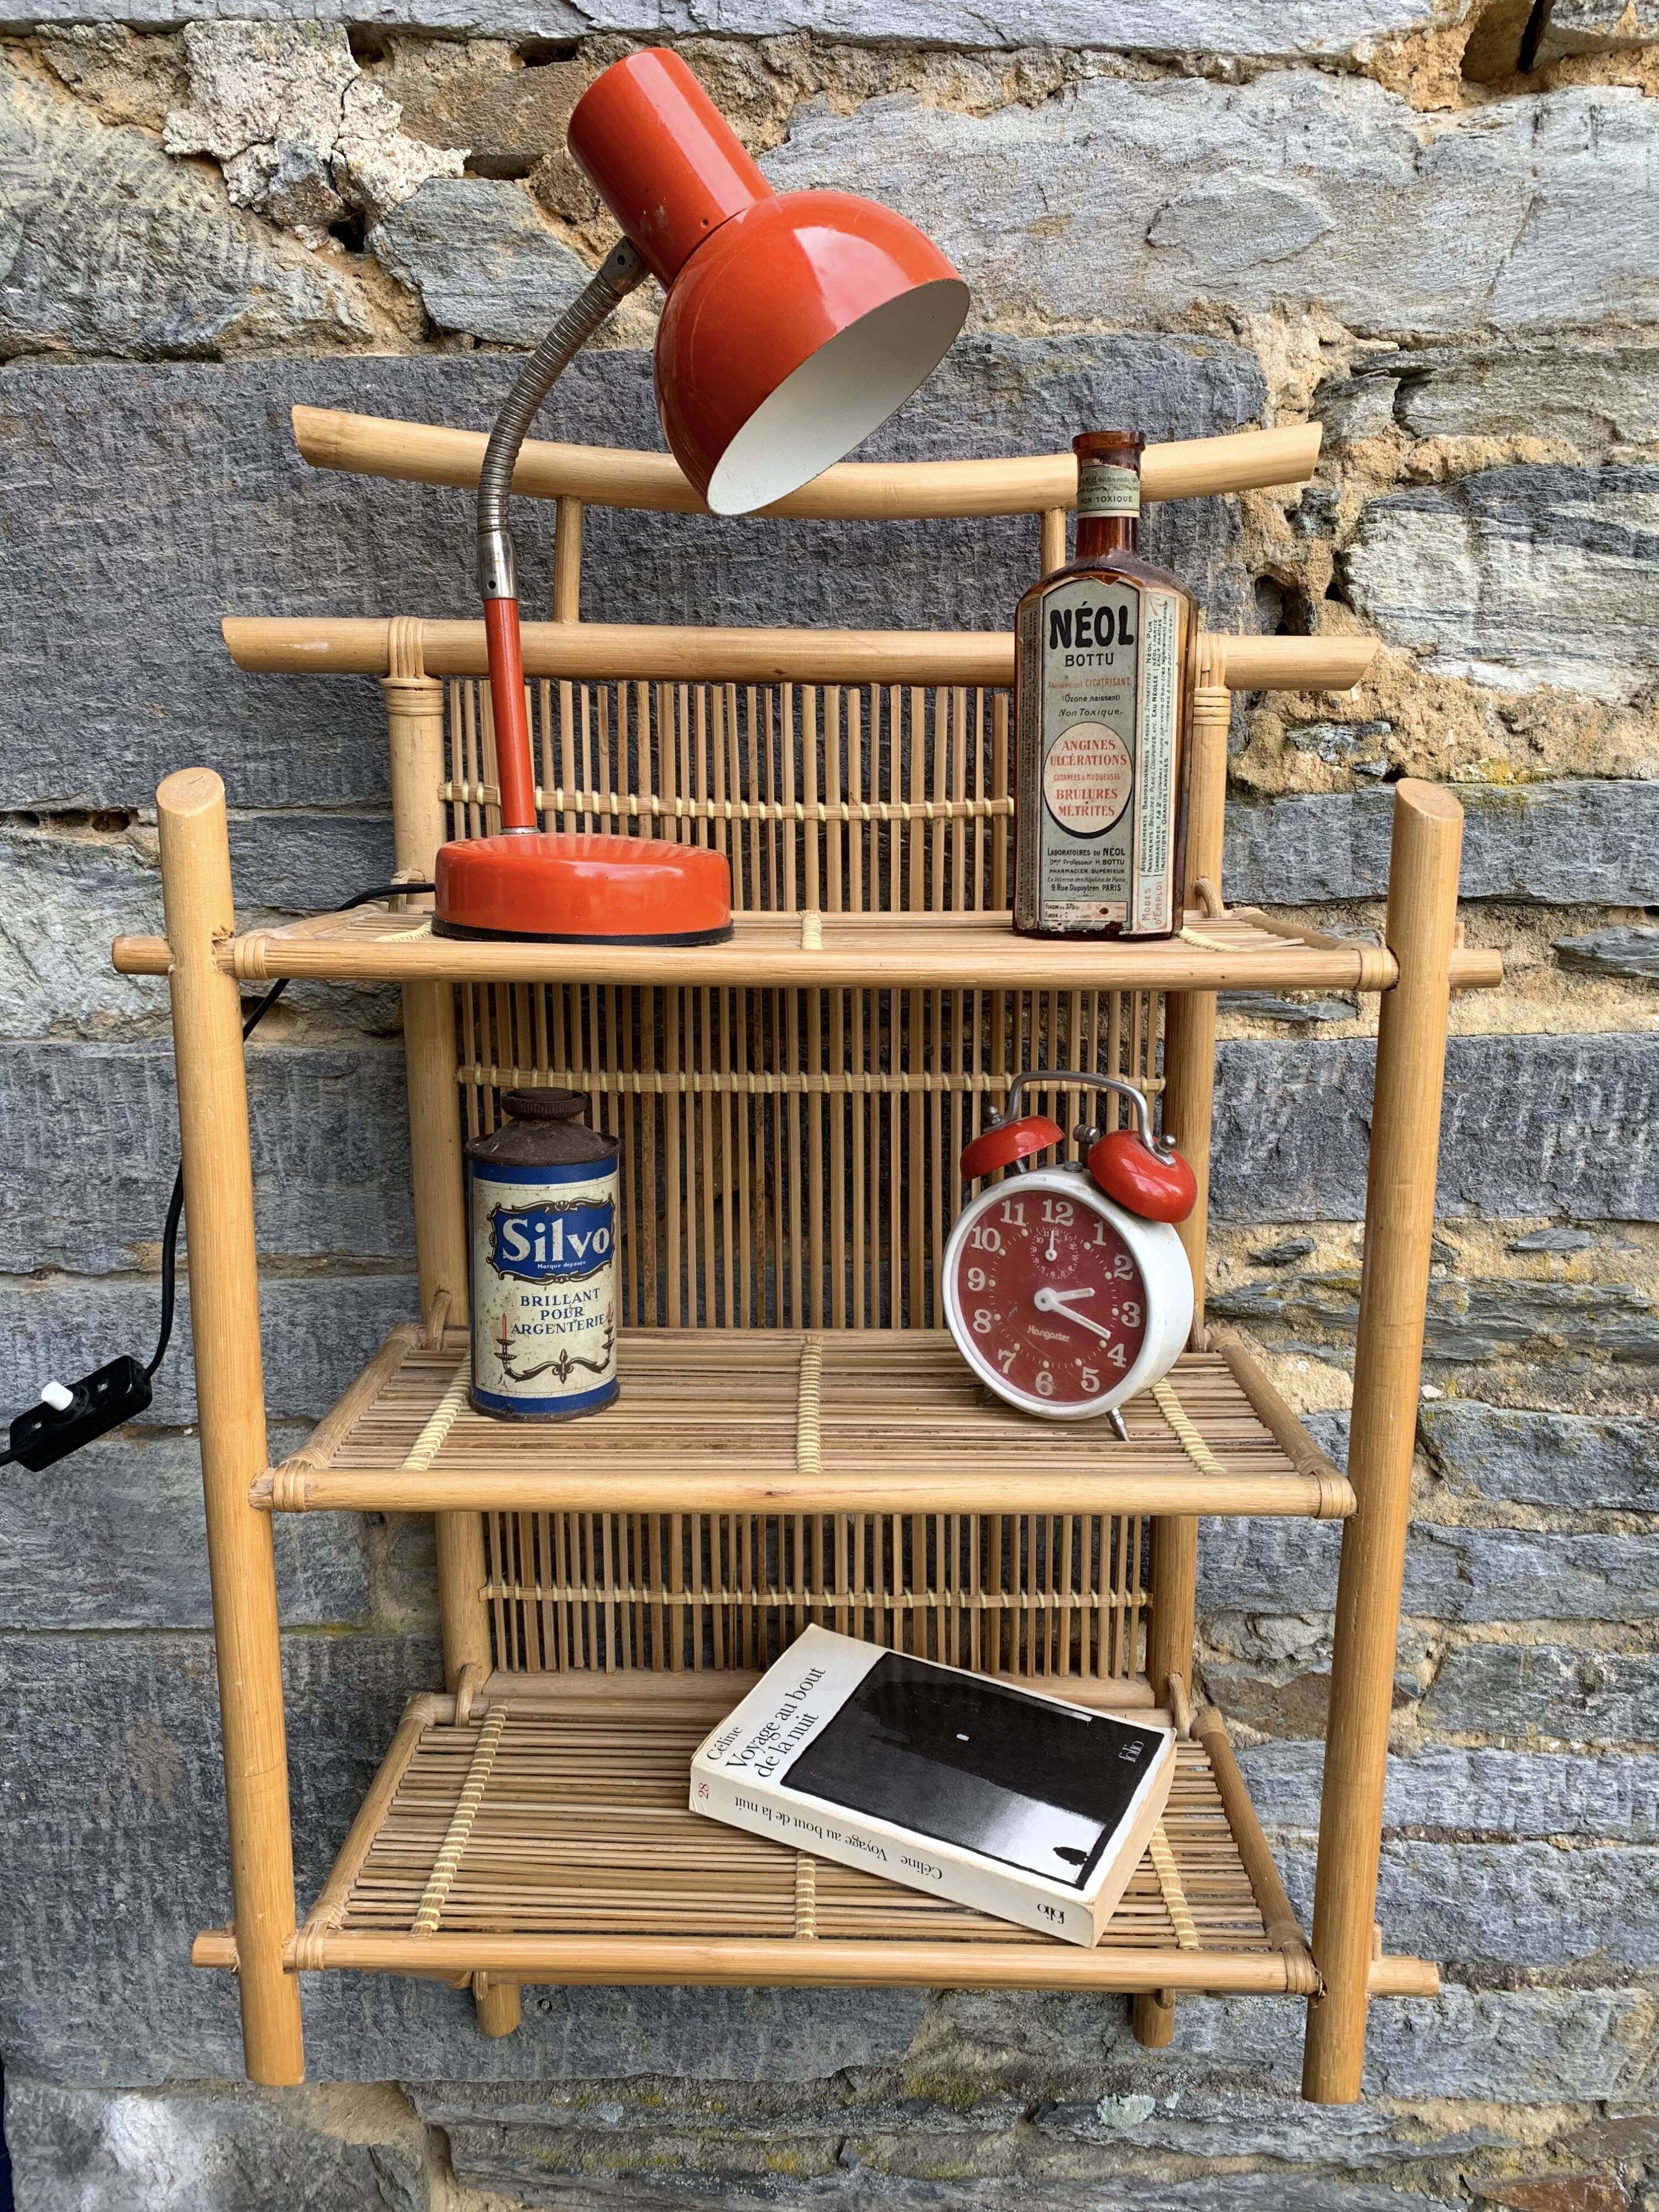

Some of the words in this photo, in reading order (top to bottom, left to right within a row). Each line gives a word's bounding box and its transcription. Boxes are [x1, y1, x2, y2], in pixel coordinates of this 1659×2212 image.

[1050, 601, 1134, 650] NÉOL
[1064, 653, 1114, 667] BOTTU
[1058, 708, 1077, 717] Non
[1079, 708, 1123, 718] Toxique.
[1062, 739, 1115, 751] ANGINES
[1050, 753, 1127, 766] ULCÉRATIONS
[1086, 773, 1120, 781] MUQUEUSES
[1058, 804, 1115, 817] MÉTRITES
[1047, 847, 1091, 857] LABORATOIRES
[1103, 846, 1126, 856] NÉOL
[1141, 888, 1151, 921] MODES
[1153, 881, 1162, 925] D'EMPLOI
[1000, 1200, 1026, 1227] 11
[1041, 1199, 1074, 1227] 12
[503, 1218, 609, 1262] Silvo
[971, 1225, 1001, 1252] 10
[1092, 1221, 1107, 1246] 1
[968, 1267, 985, 1291] 9
[1114, 1254, 1134, 1281] 2
[520, 1287, 600, 1307] BRILLANT
[511, 1313, 605, 1335] ARGENTERIE
[540, 1306, 585, 1321] POUR
[973, 1309, 992, 1333] 8
[1121, 1301, 1141, 1327] 3
[998, 1348, 1016, 1374] 7
[1107, 1343, 1127, 1368] 4
[1035, 1371, 1053, 1396] 6
[1081, 1366, 1100, 1392] 5
[785, 1667, 826, 1701] bout
[775, 1703, 798, 1721] au
[707, 1726, 743, 1760] Céline
[724, 1721, 781, 1767] Voyage
[754, 1756, 780, 1778] de
[768, 1743, 795, 1755] la
[787, 1713, 819, 1740] nuit
[1118, 1740, 1145, 1763] folio
[698, 1782, 710, 1799] 28
[734, 1796, 758, 1813] nuit
[761, 1806, 773, 1821] la
[776, 1811, 790, 1826] de
[794, 1818, 822, 1839] bout
[827, 1829, 841, 1842] au
[845, 1834, 888, 1861] Voyage
[900, 1855, 942, 1880] Céline
[1037, 1903, 1065, 1924] folio
